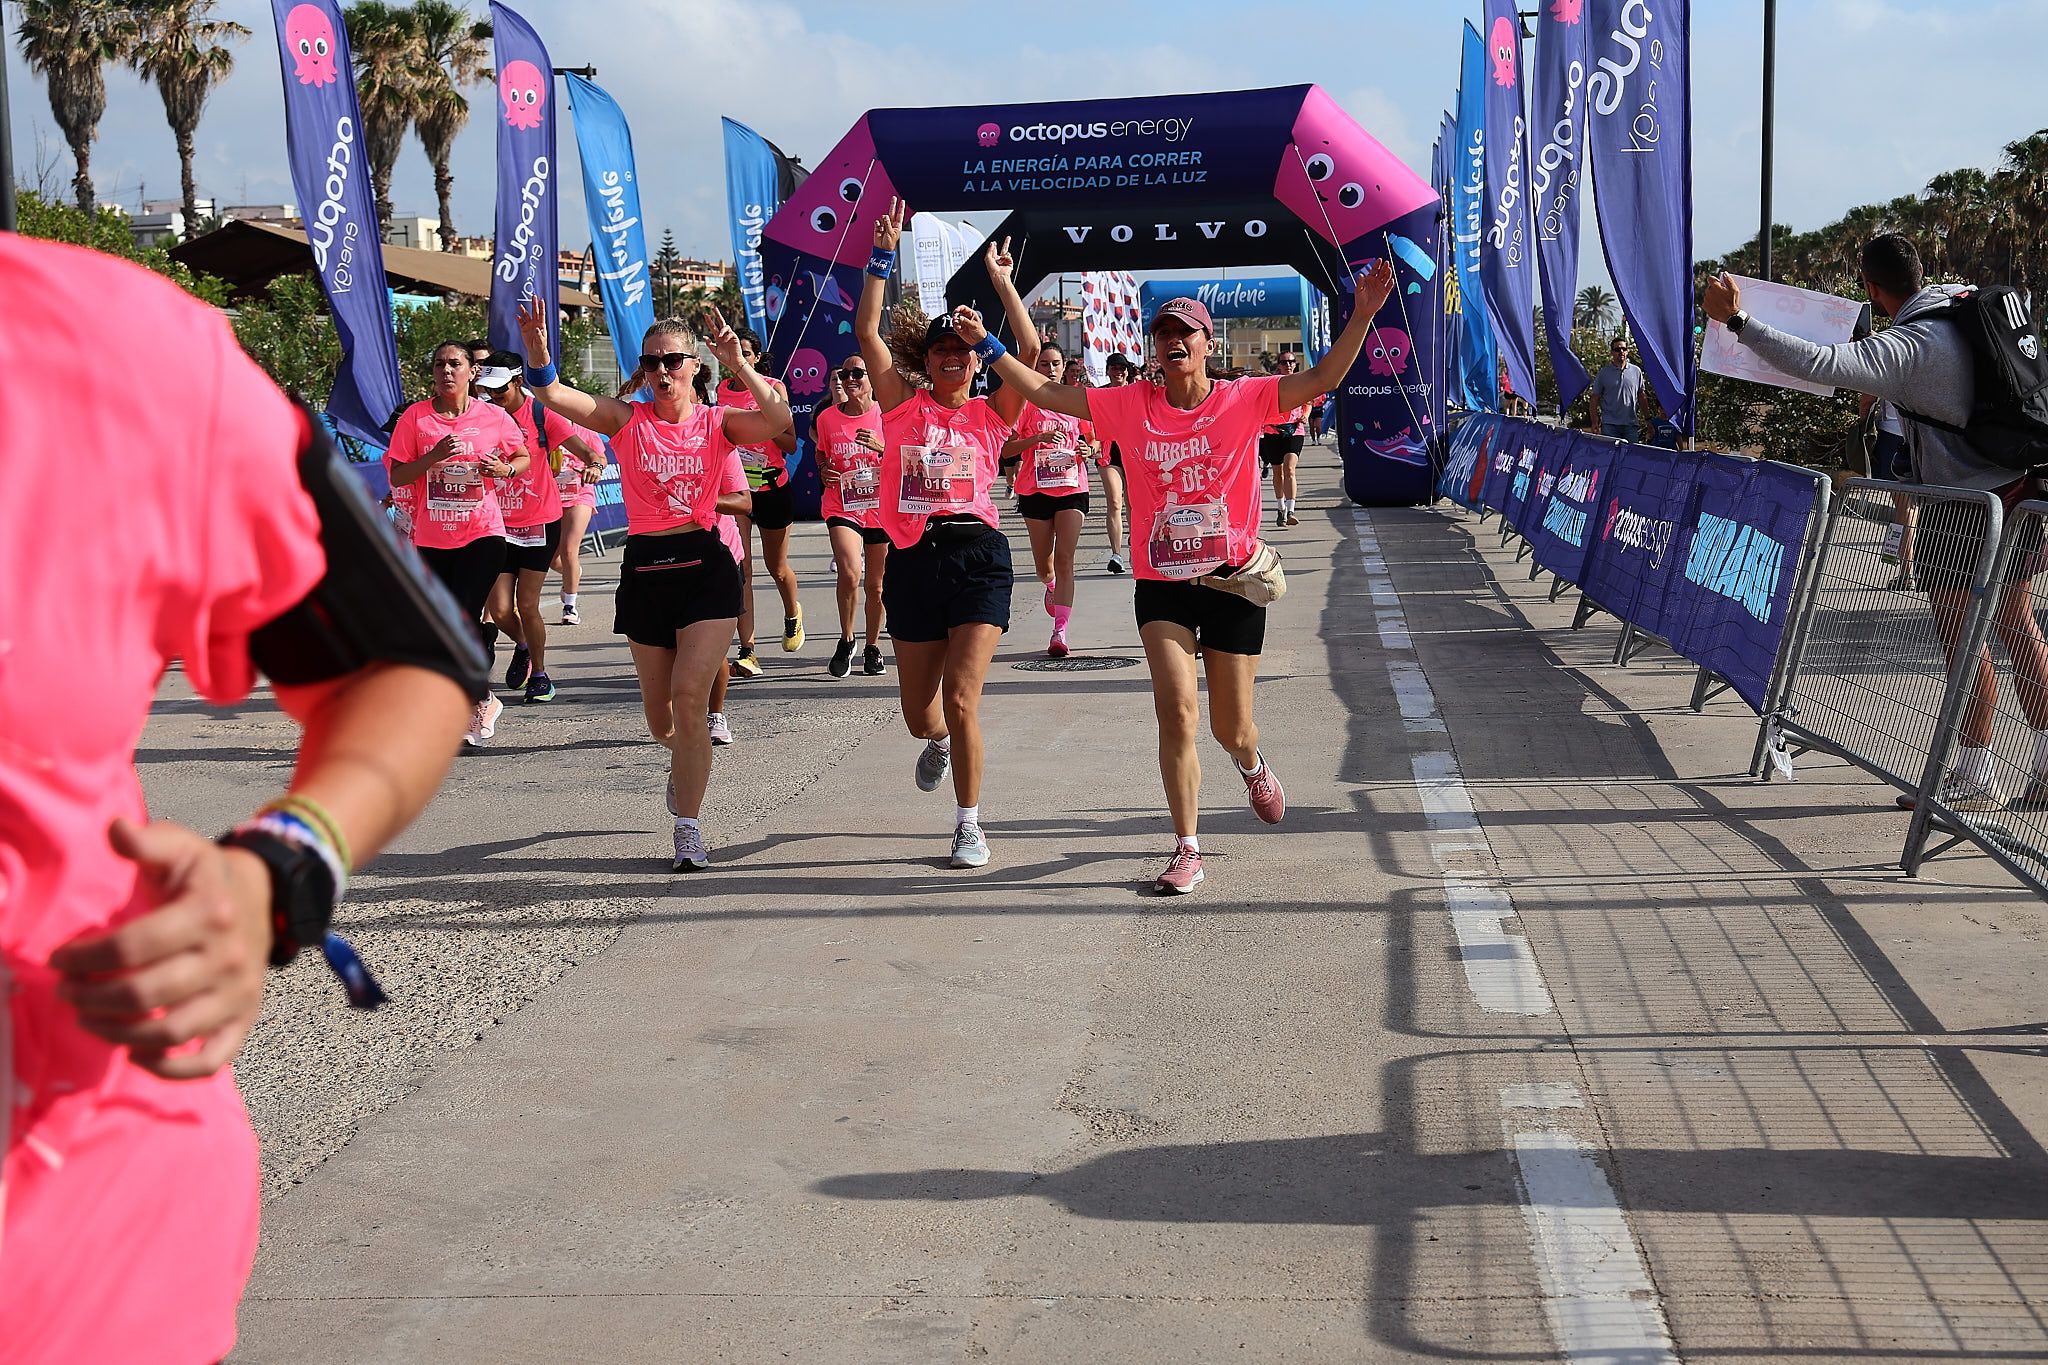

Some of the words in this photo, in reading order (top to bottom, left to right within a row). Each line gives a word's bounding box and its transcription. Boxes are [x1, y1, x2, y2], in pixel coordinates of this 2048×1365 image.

[1009, 122, 1107, 145] octopus
[1110, 117, 1193, 142] energy
[963, 160, 986, 174] LA
[991, 154, 1069, 173] ENERGÍA
[1074, 155, 1123, 170] PARA
[1128, 151, 1203, 167] CORRER
[963, 180, 976, 192] A
[980, 179, 1003, 192] LA
[1008, 175, 1111, 191] VELOCIDAD
[1115, 174, 1140, 187] DE
[1144, 172, 1168, 185] LA
[1172, 170, 1208, 184] LUZ
[1063, 219, 1267, 244] VOLVO
[1197, 282, 1266, 314] Marlene
[1348, 384, 1392, 398] octopus
[1393, 382, 1433, 396] energy
[1144, 435, 1212, 462] CARRERA
[641, 454, 704, 475] CARRERA
[1050, 465, 1067, 473] 016
[924, 479, 951, 490] 016
[1181, 463, 1206, 493] DE
[444, 483, 467, 493] 016
[856, 486, 875, 495] 016
[498, 497, 523, 509] UJER
[907, 503, 932, 512] OYSHO
[429, 509, 470, 522] MUJER
[1172, 537, 1203, 552] 016
